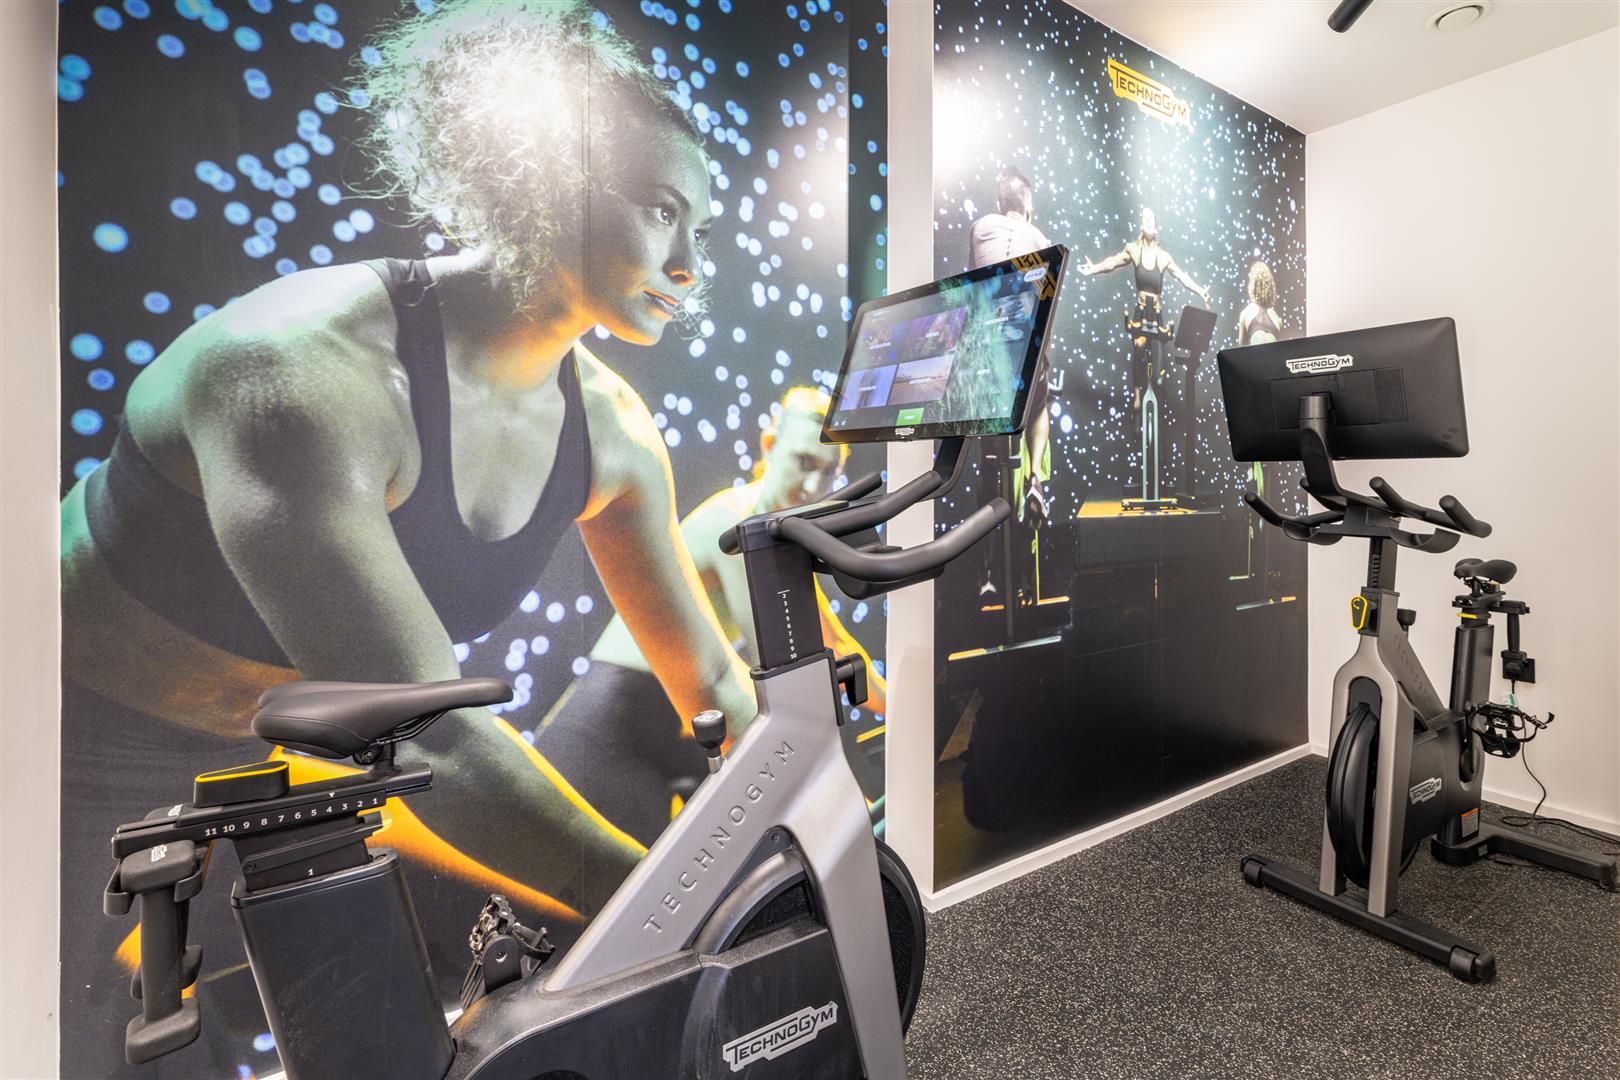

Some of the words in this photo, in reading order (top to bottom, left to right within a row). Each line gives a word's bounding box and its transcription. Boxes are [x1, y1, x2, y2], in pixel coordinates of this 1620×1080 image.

[204, 828, 217, 836] 11
[222, 824, 236, 833] 10
[242, 821, 250, 830] 9
[260, 818, 268, 826] 8
[278, 814, 285, 823] 7
[294, 811, 302, 820] 6
[311, 808, 317, 816] 5
[342, 803, 348, 811] 3
[357, 800, 364, 808] 2
[372, 797, 378, 805] 1
[643, 740, 794, 934] TECHNOGYM
[308, 868, 314, 876] 1
[726, 1006, 834, 1065] TECHNOGYM
